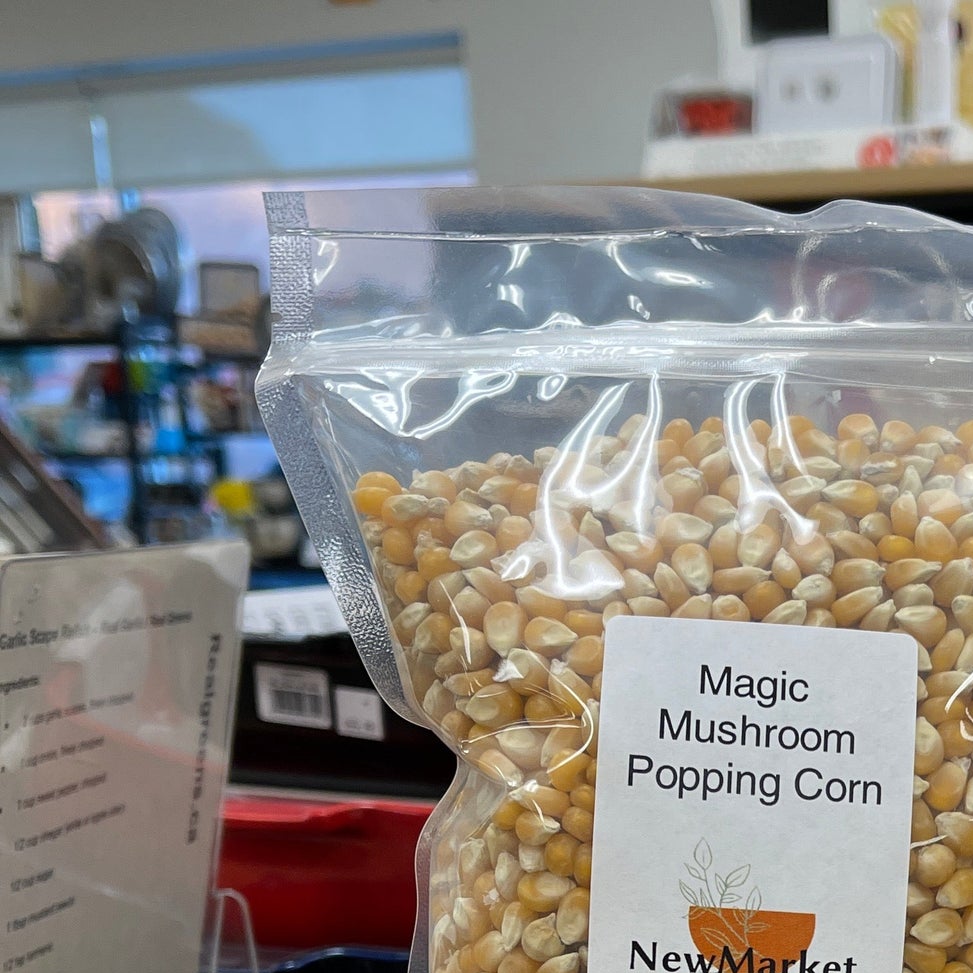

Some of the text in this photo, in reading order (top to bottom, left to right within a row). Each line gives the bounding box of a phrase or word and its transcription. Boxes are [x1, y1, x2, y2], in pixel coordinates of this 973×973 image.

[700, 664, 809, 709] Magic
[659, 708, 855, 755] Mushroom
[627, 754, 883, 807] Popping Corn
